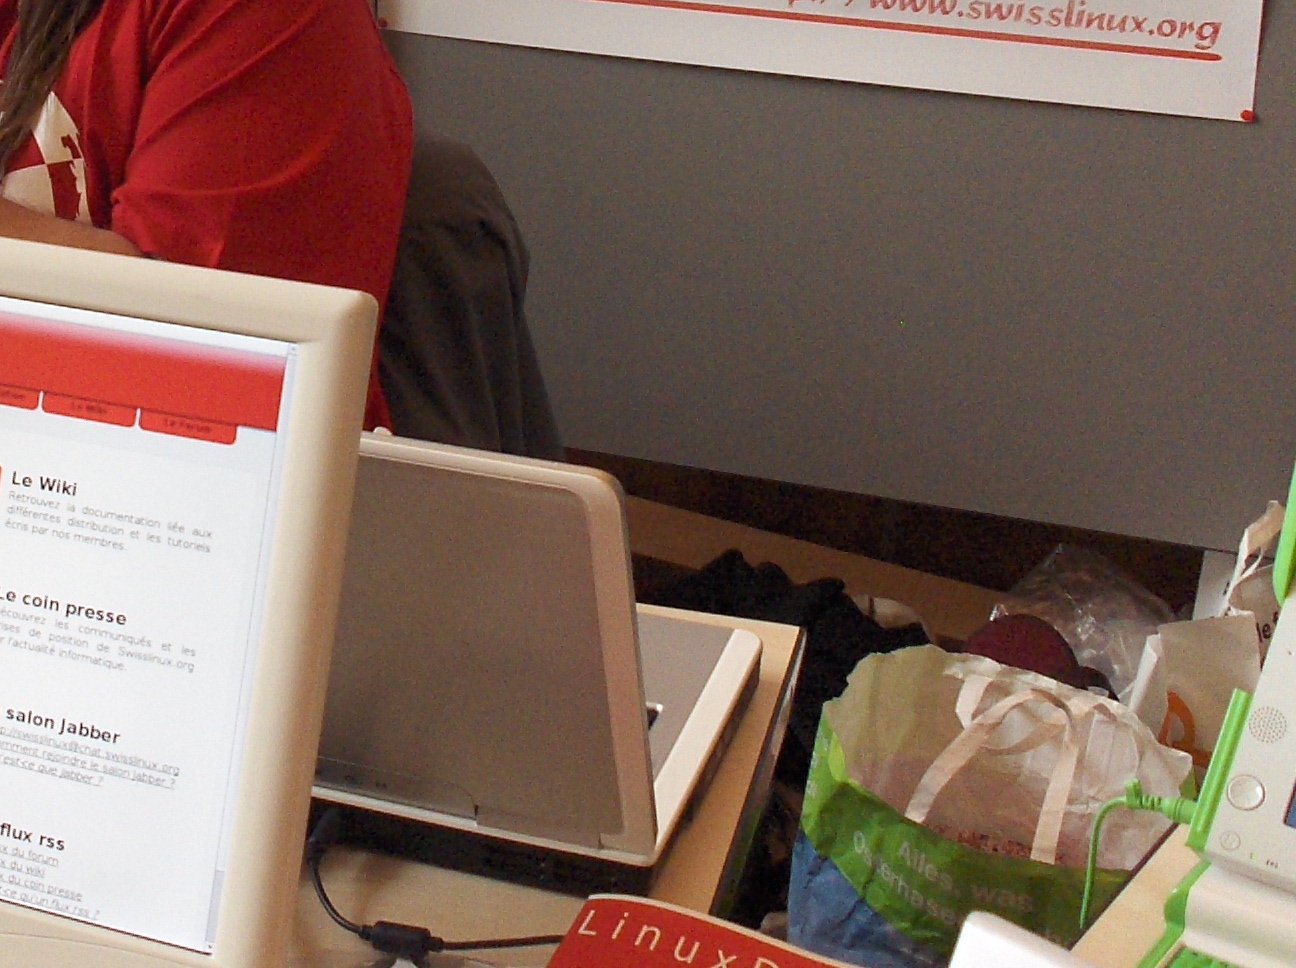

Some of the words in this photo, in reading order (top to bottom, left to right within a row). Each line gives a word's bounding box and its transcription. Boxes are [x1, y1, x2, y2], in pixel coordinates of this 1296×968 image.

[11, 471, 33, 487] Le
[40, 476, 77, 496] Wiki
[22, 592, 59, 612] coin
[66, 601, 127, 626] presse
[5, 707, 55, 730] salon
[59, 717, 121, 745] Jabber
[0, 822, 33, 844] flux
[39, 833, 66, 851] rss
